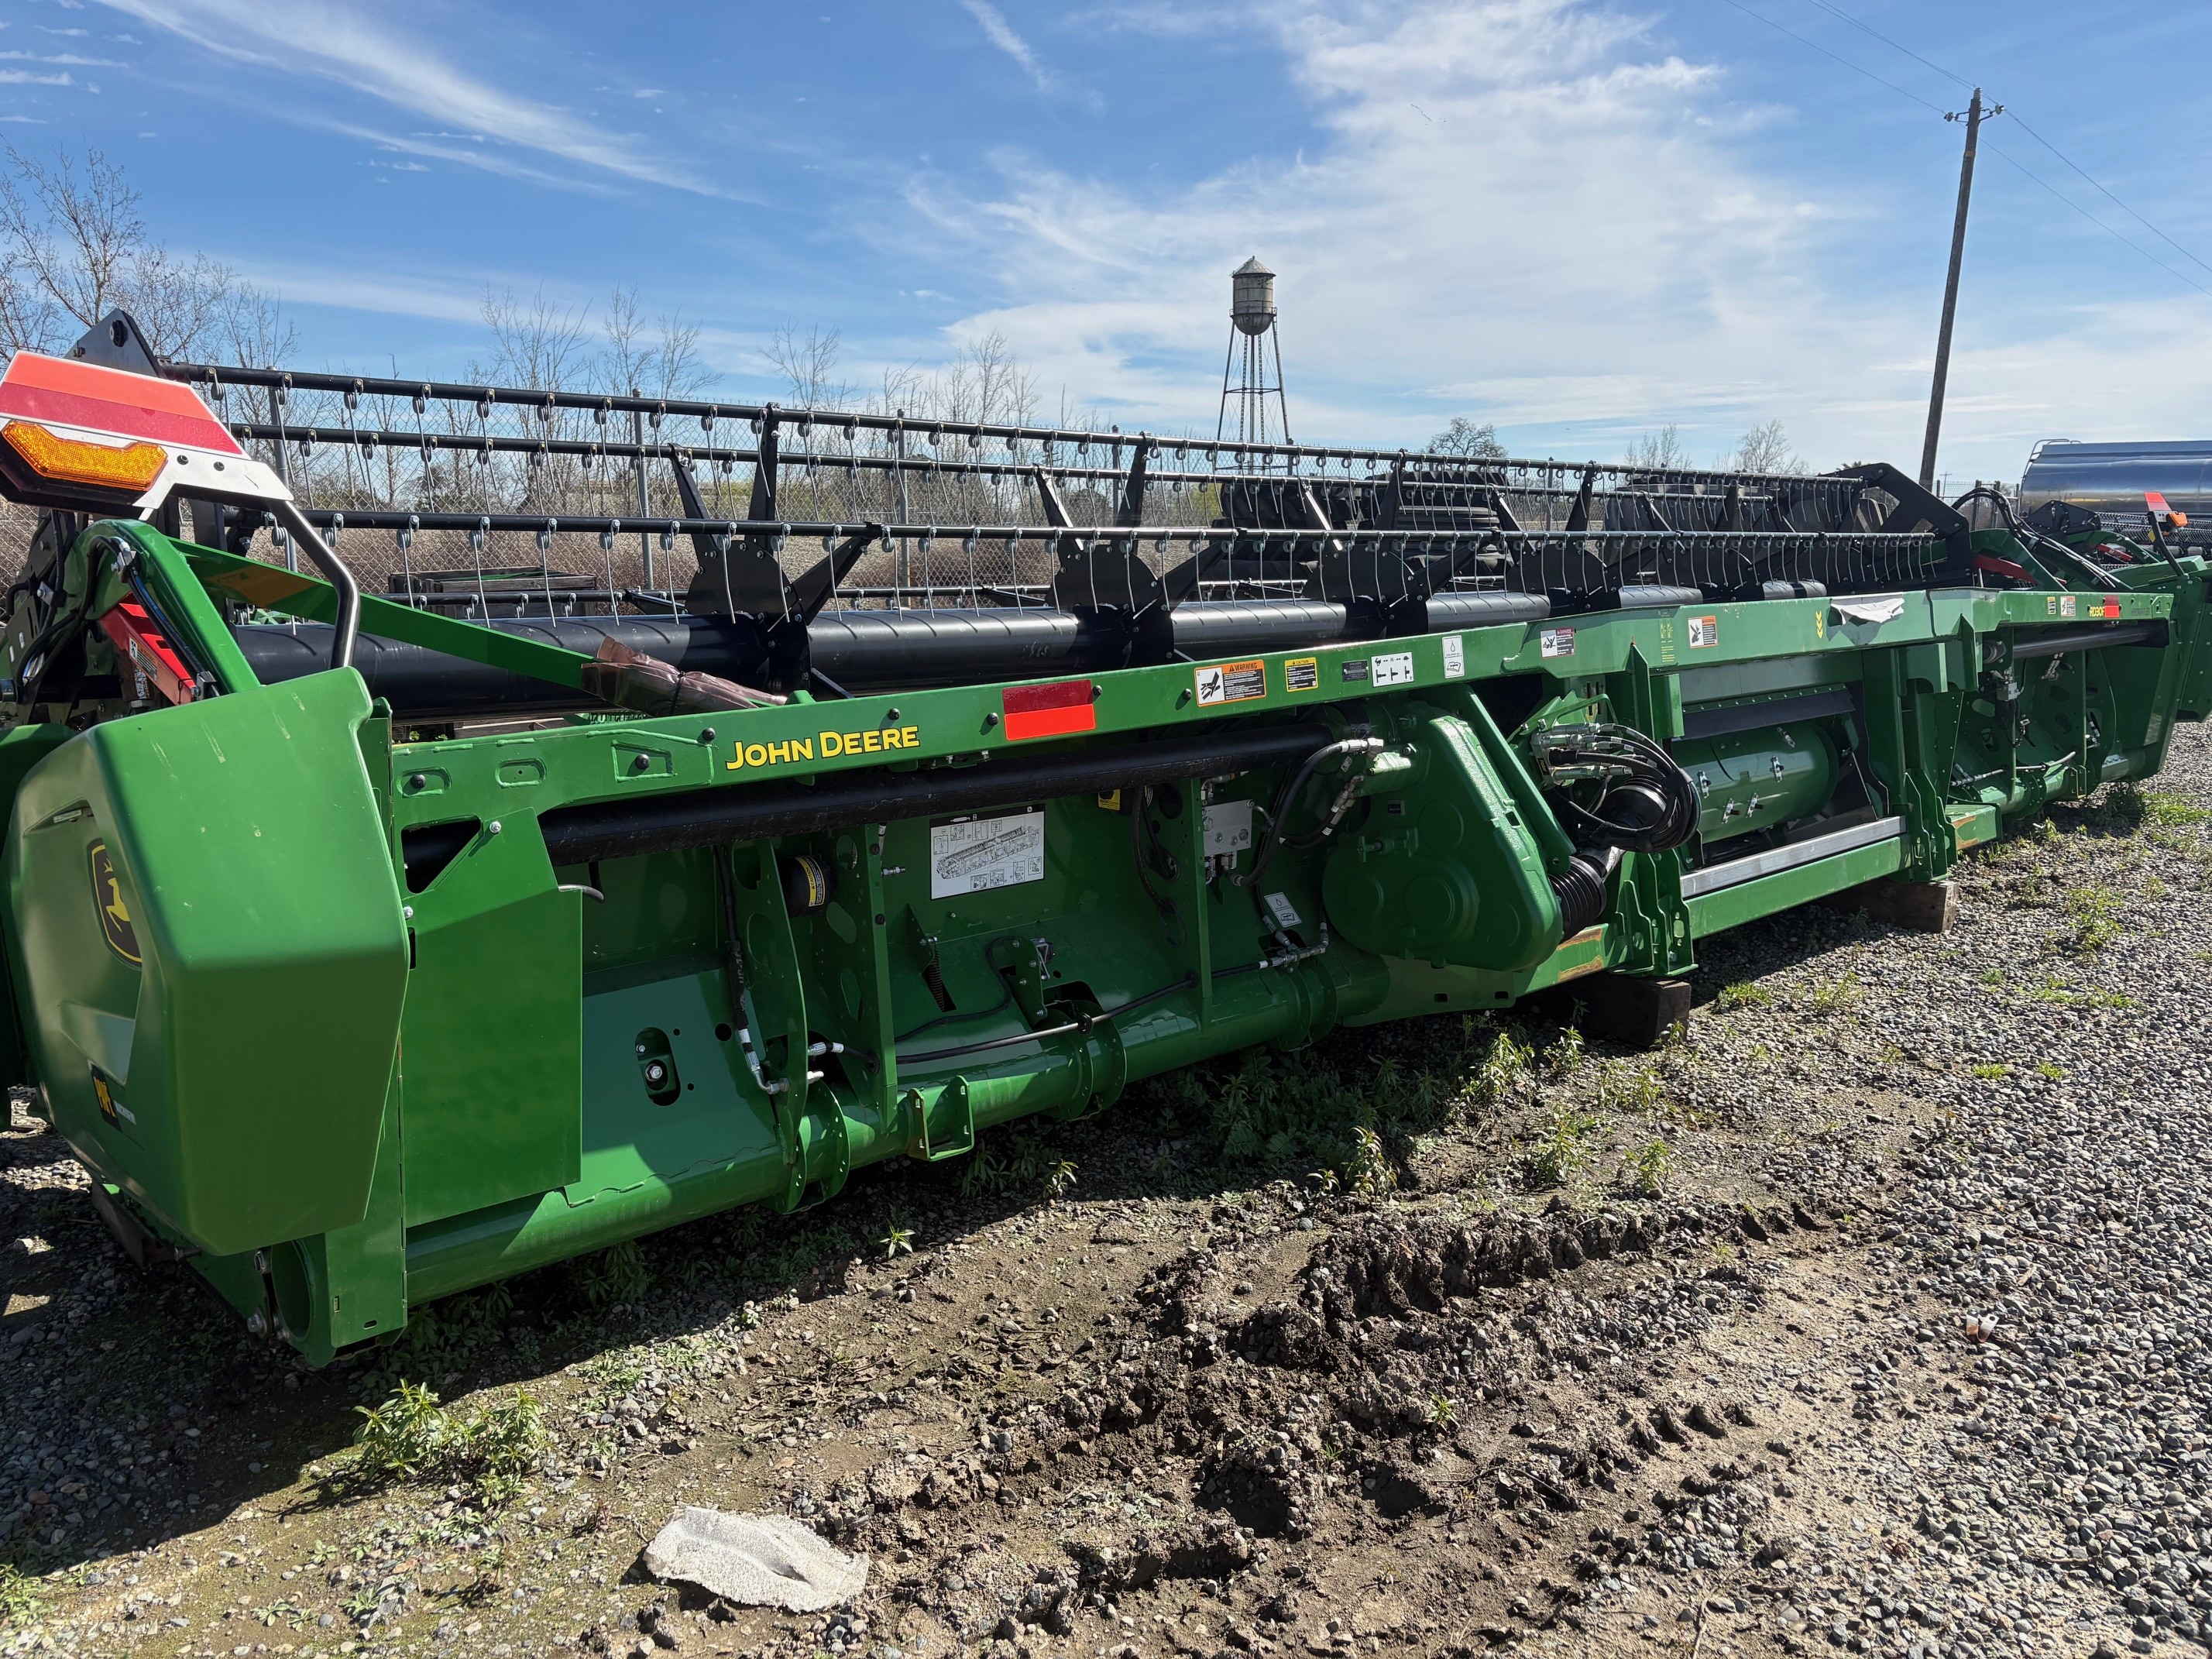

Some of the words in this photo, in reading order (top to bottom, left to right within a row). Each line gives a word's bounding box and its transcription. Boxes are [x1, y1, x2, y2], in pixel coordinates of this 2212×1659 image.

[1235, 662, 1258, 672] WARNING
[726, 739, 815, 771] JOHN
[818, 726, 921, 759] DEERE
